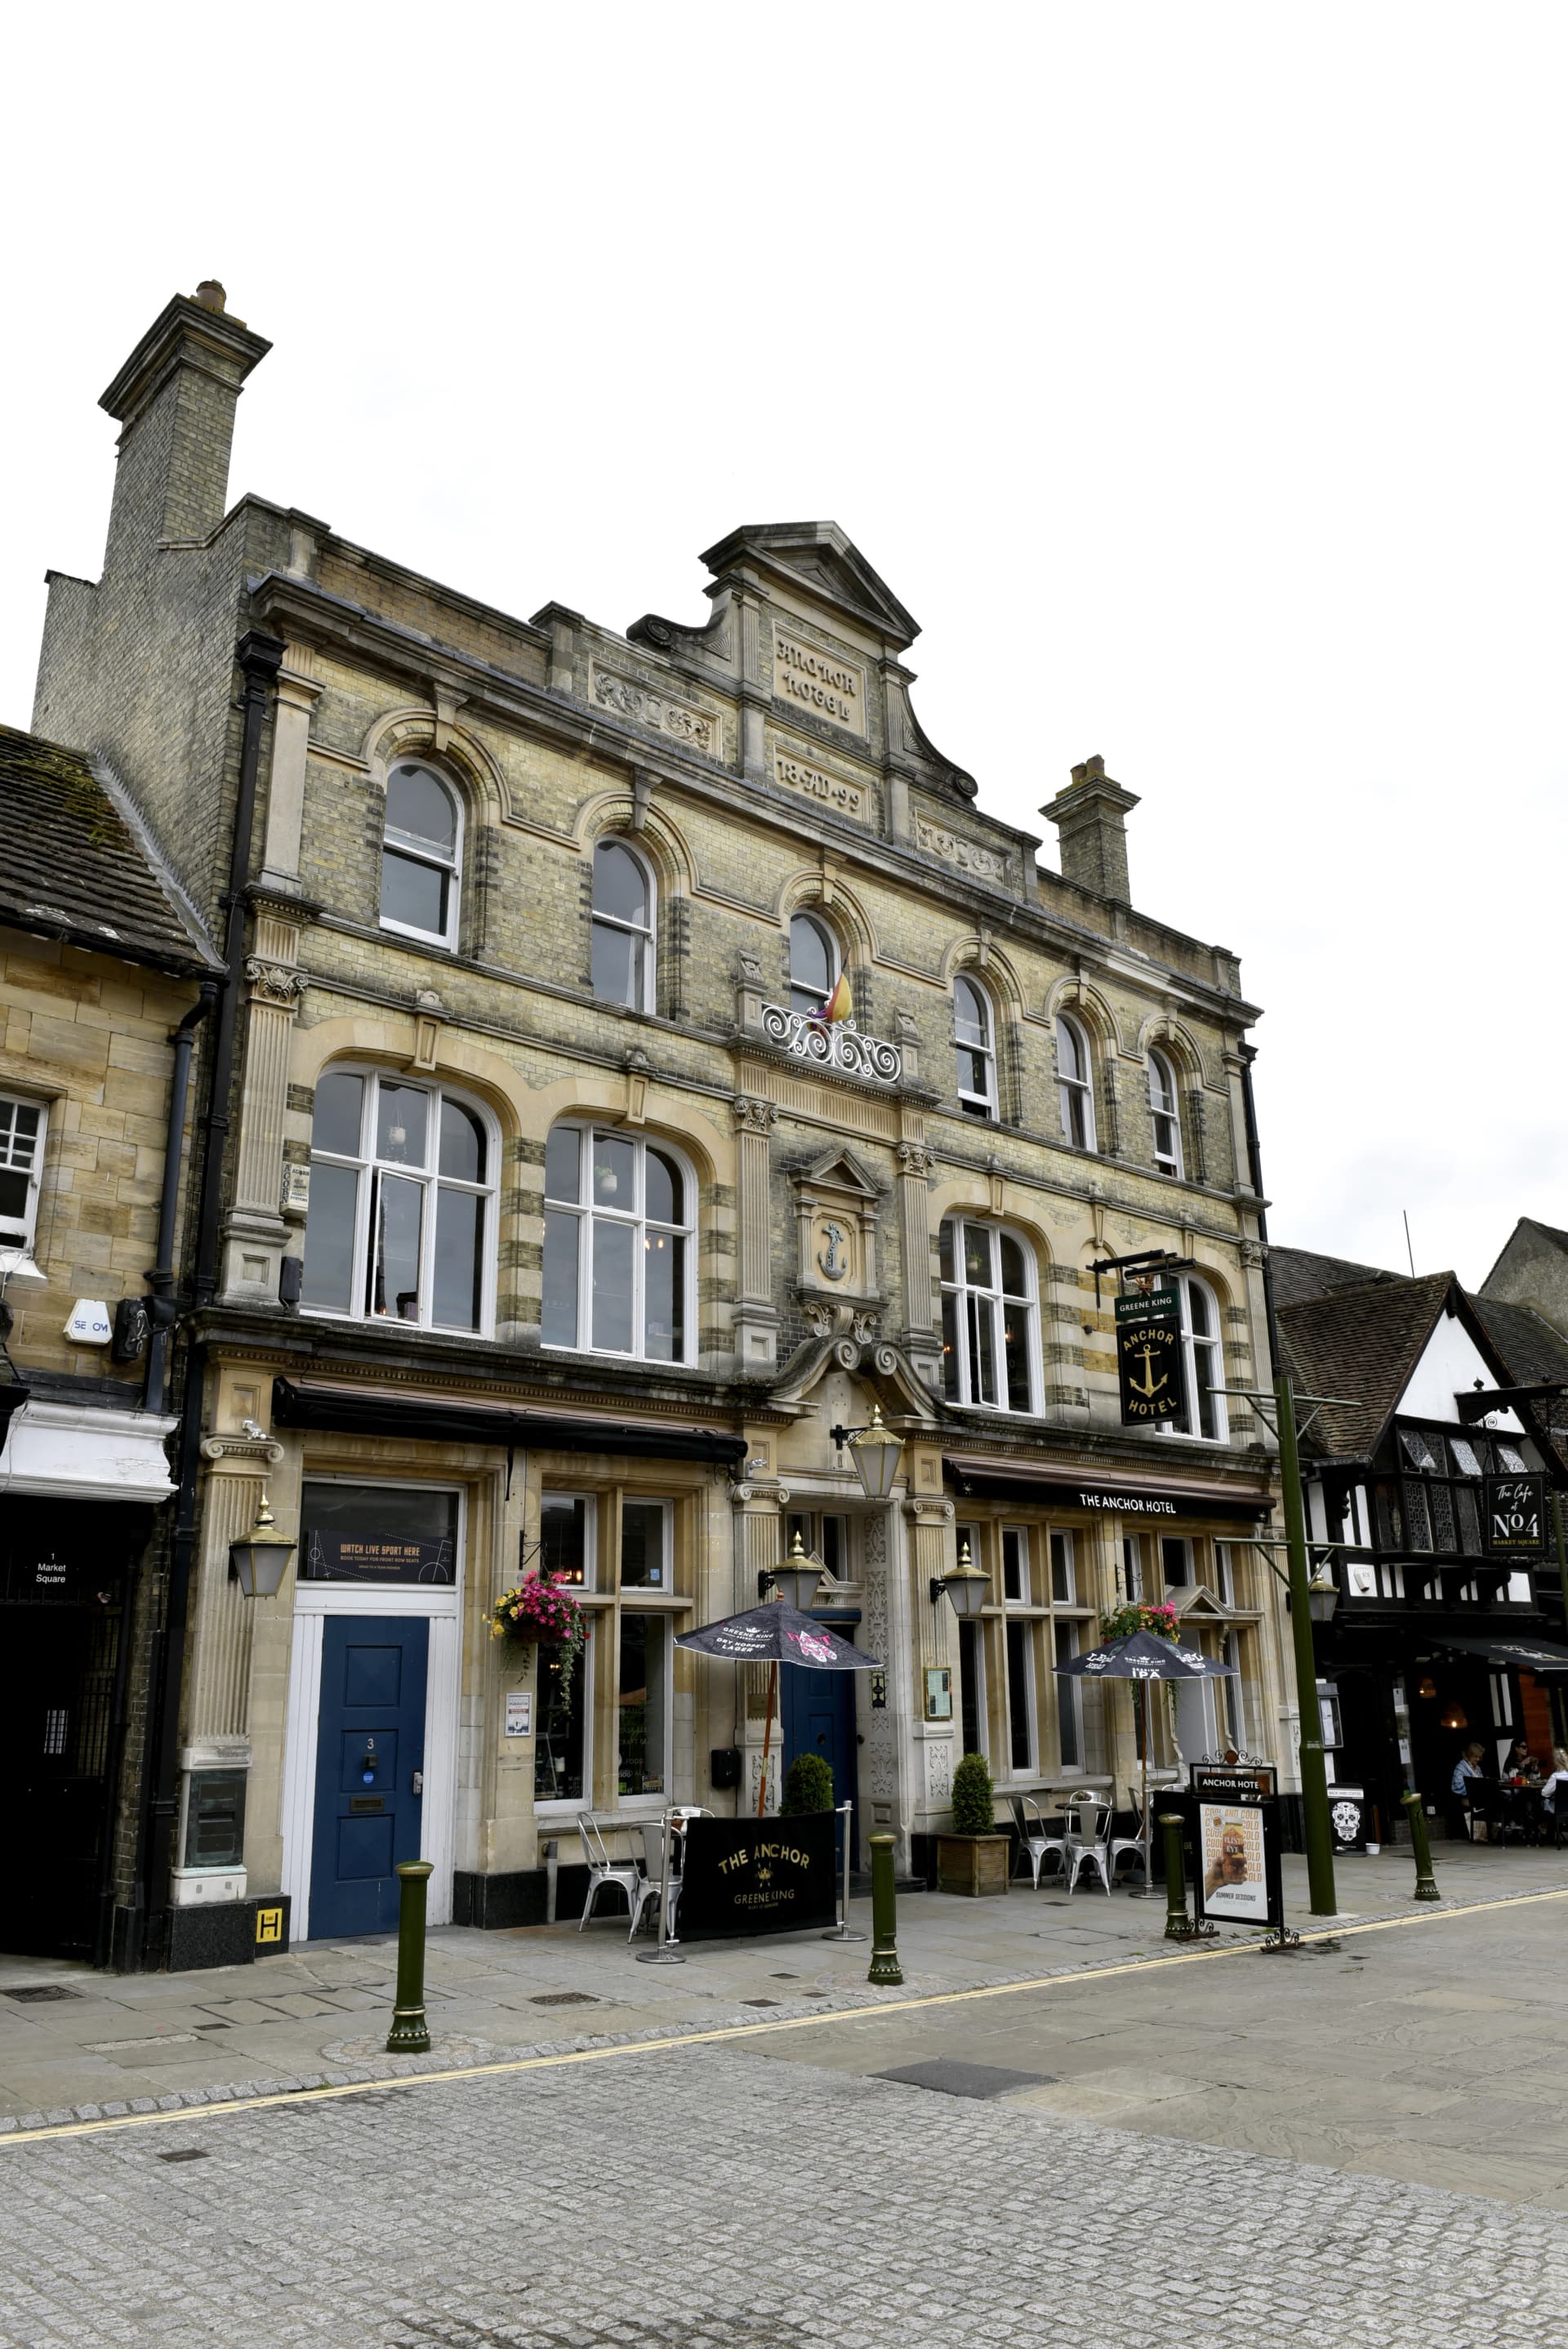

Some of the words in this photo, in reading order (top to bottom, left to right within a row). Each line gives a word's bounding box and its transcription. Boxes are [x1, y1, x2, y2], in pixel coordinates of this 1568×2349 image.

[782, 671, 849, 720] HOTEL
[282, 1164, 291, 1203] ACORN
[1120, 1301, 1150, 1313] GREENE
[1152, 1296, 1172, 1307] KING
[1123, 1329, 1174, 1352] ANCHOR
[1128, 1397, 1177, 1415] HOTEL
[1496, 1483, 1513, 1500] The
[1080, 1494, 1100, 1507] THE
[1102, 1496, 1145, 1511] ANCHOR
[1146, 1500, 1176, 1513] HOTEL
[1510, 1501, 1519, 1511] at
[340, 1544, 363, 1553] WATCH
[365, 1545, 380, 1555] LIVE
[381, 1545, 402, 1556] SPORT
[403, 1547, 421, 1557] HERE
[38, 1562, 66, 1572] Market
[36, 1574, 66, 1585] Square
[723, 1627, 754, 1638] GREENE
[722, 1644, 754, 1652] LAGER
[1132, 1670, 1161, 1678] IPA
[368, 1738, 374, 1749] 3
[1202, 1778, 1236, 1788] ANCHOR
[1241, 1809, 1259, 1820] COLD
[718, 1848, 750, 1874] THE
[754, 1843, 810, 1870] ANCHOR
[1247, 1862, 1262, 1872] OLD
[1248, 1873, 1262, 1882] OLD
[734, 1892, 770, 1905] GREENE
[771, 1889, 795, 1901] KING
[1235, 1893, 1257, 1901] SESSIONS
[260, 1912, 278, 1939] H
